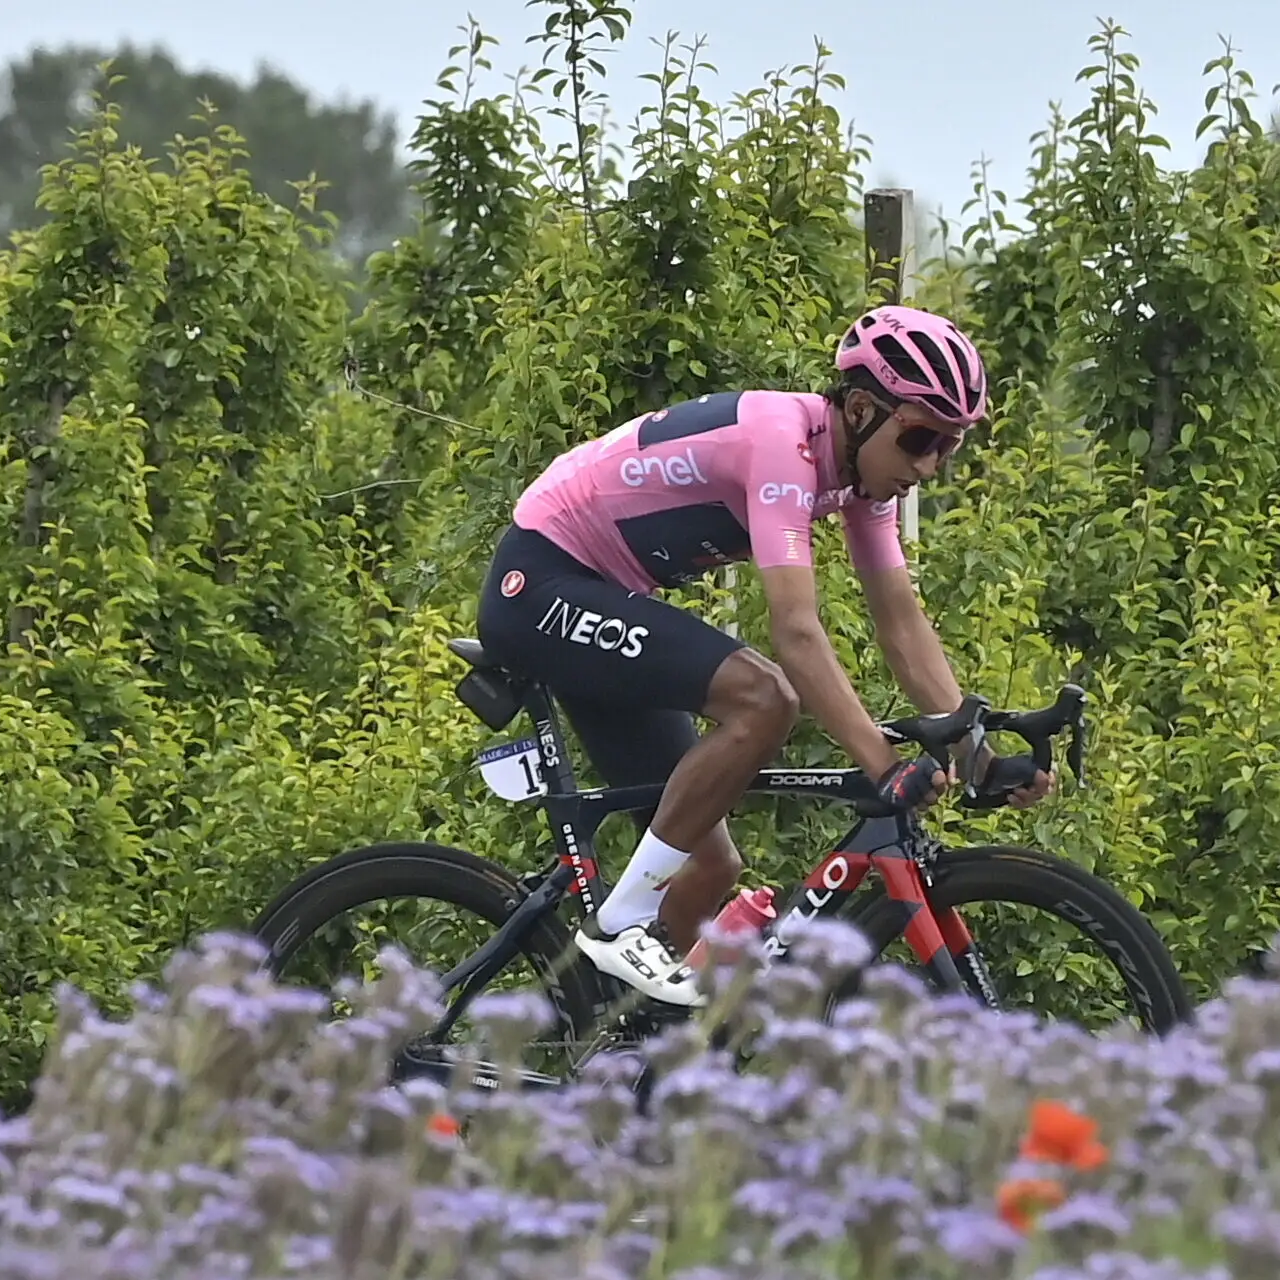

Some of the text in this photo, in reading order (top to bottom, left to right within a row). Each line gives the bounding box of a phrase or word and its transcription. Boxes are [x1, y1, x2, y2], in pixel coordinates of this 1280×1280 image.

[620, 447, 708, 487] enel
[535, 596, 650, 658] INEOS
[536, 718, 560, 768] INEOS
[518, 754, 541, 795] 1
[770, 774, 843, 786] DOGMA
